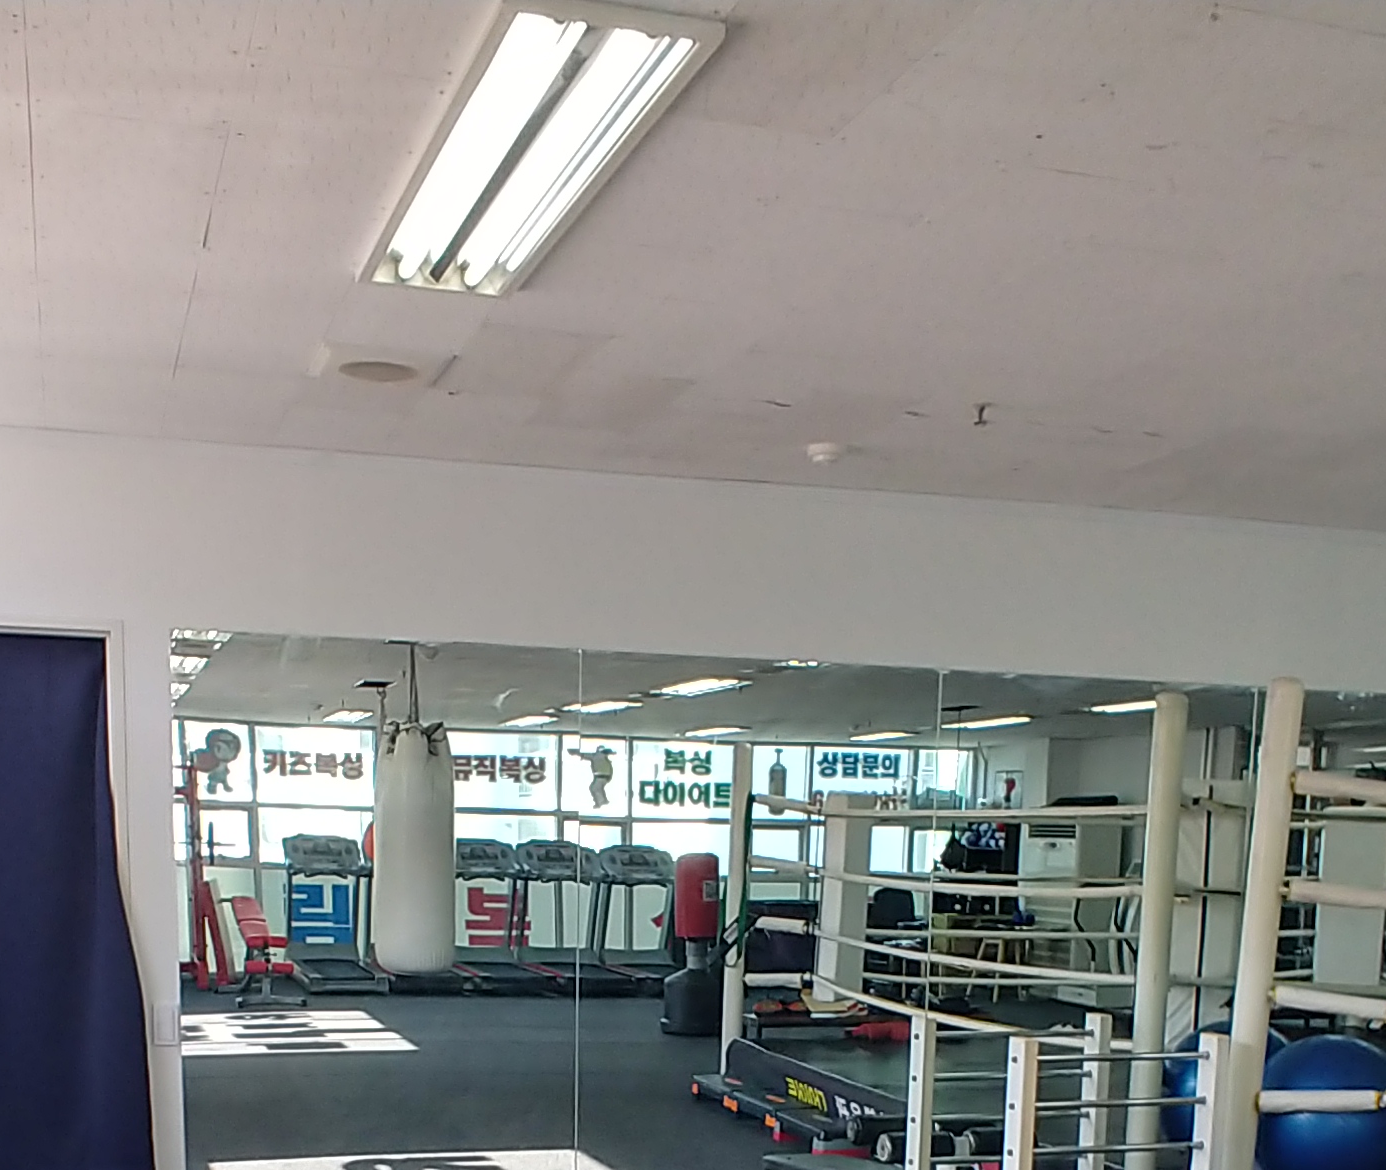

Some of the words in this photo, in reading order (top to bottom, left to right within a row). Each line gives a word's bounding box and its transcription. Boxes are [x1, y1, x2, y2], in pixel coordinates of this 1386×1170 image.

[262, 749, 364, 780] 키즈복싱
[452, 755, 546, 784] 뮤직복싱
[663, 748, 712, 776] 복싱
[816, 751, 902, 779] 상담문의
[638, 780, 732, 809] 다이어트
